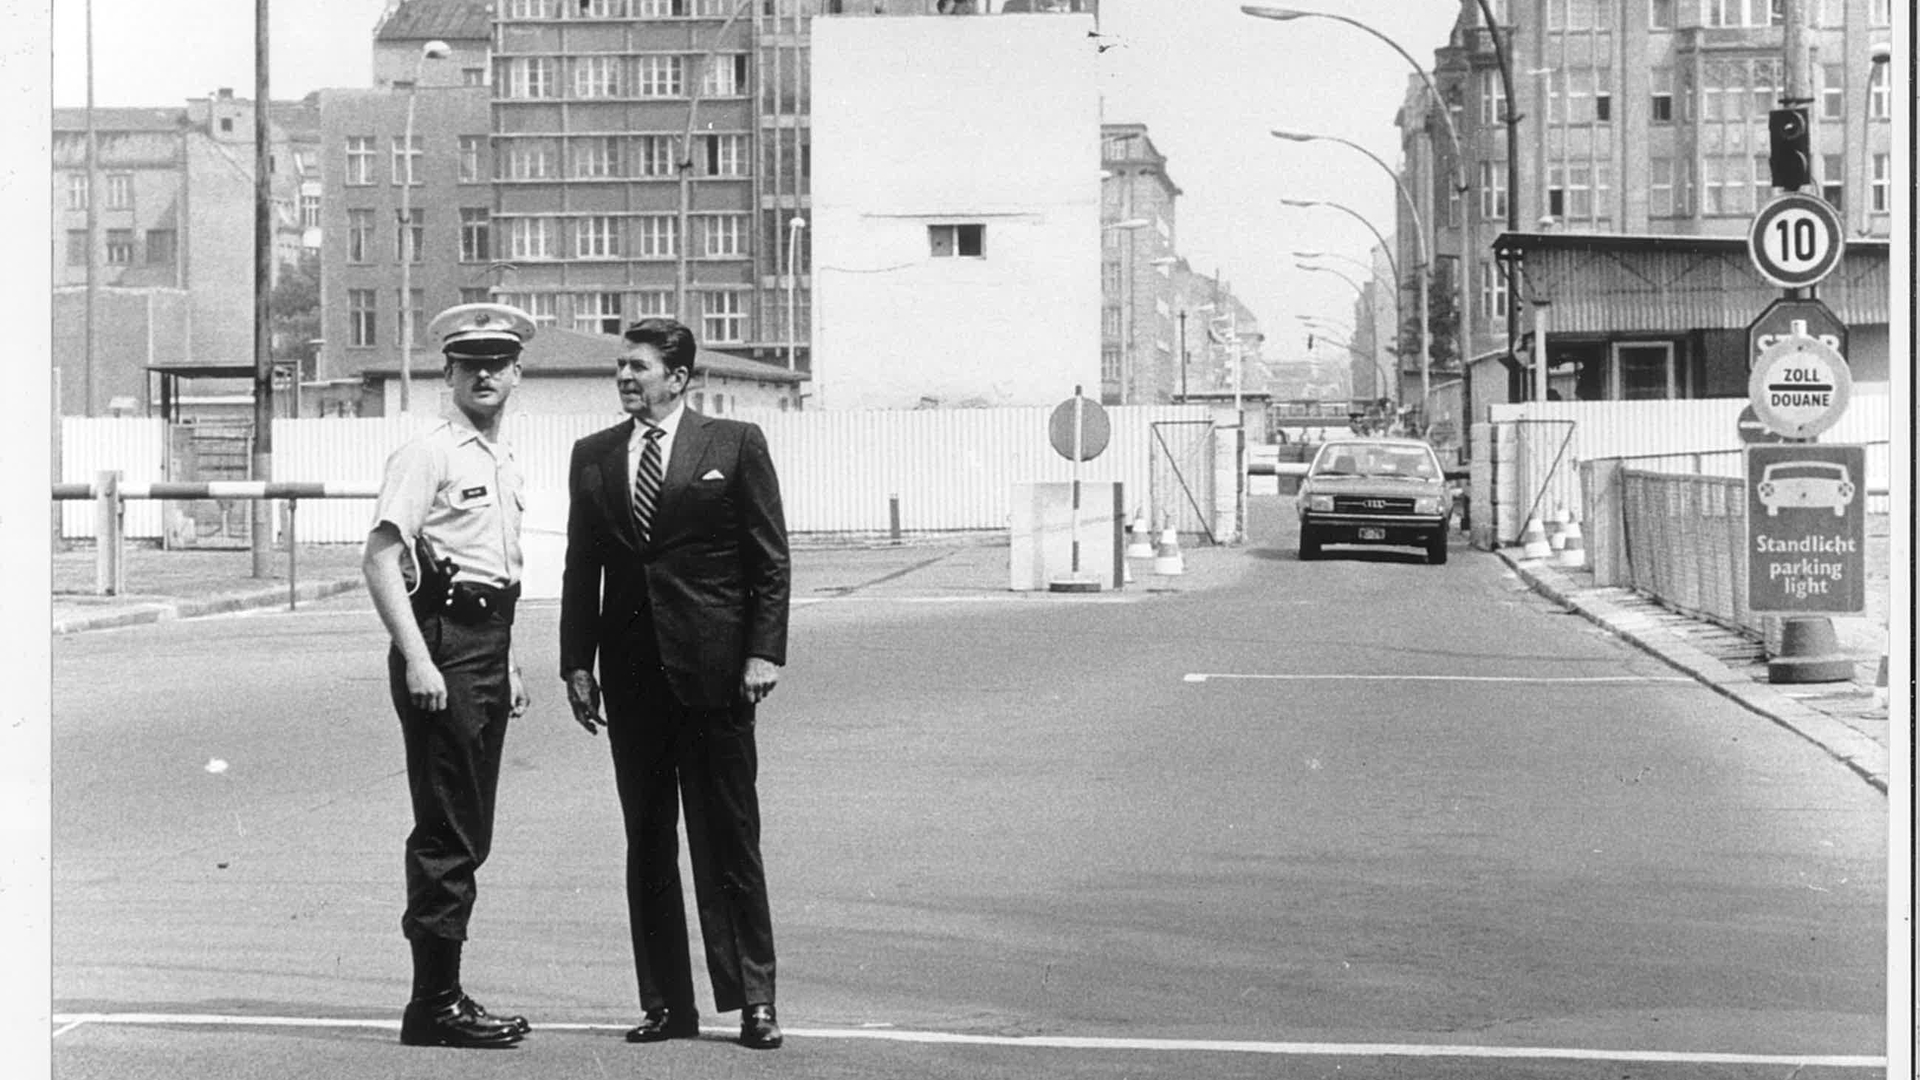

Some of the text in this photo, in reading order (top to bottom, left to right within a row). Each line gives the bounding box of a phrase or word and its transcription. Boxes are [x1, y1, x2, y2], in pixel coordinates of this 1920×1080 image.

[1776, 217, 1816, 262] 10
[1783, 368, 1820, 382] ZOLL
[1771, 393, 1830, 407] DOUANE
[1756, 535, 1857, 555] Standlicht
[1770, 558, 1842, 581] parking
[1785, 577, 1829, 599] light
